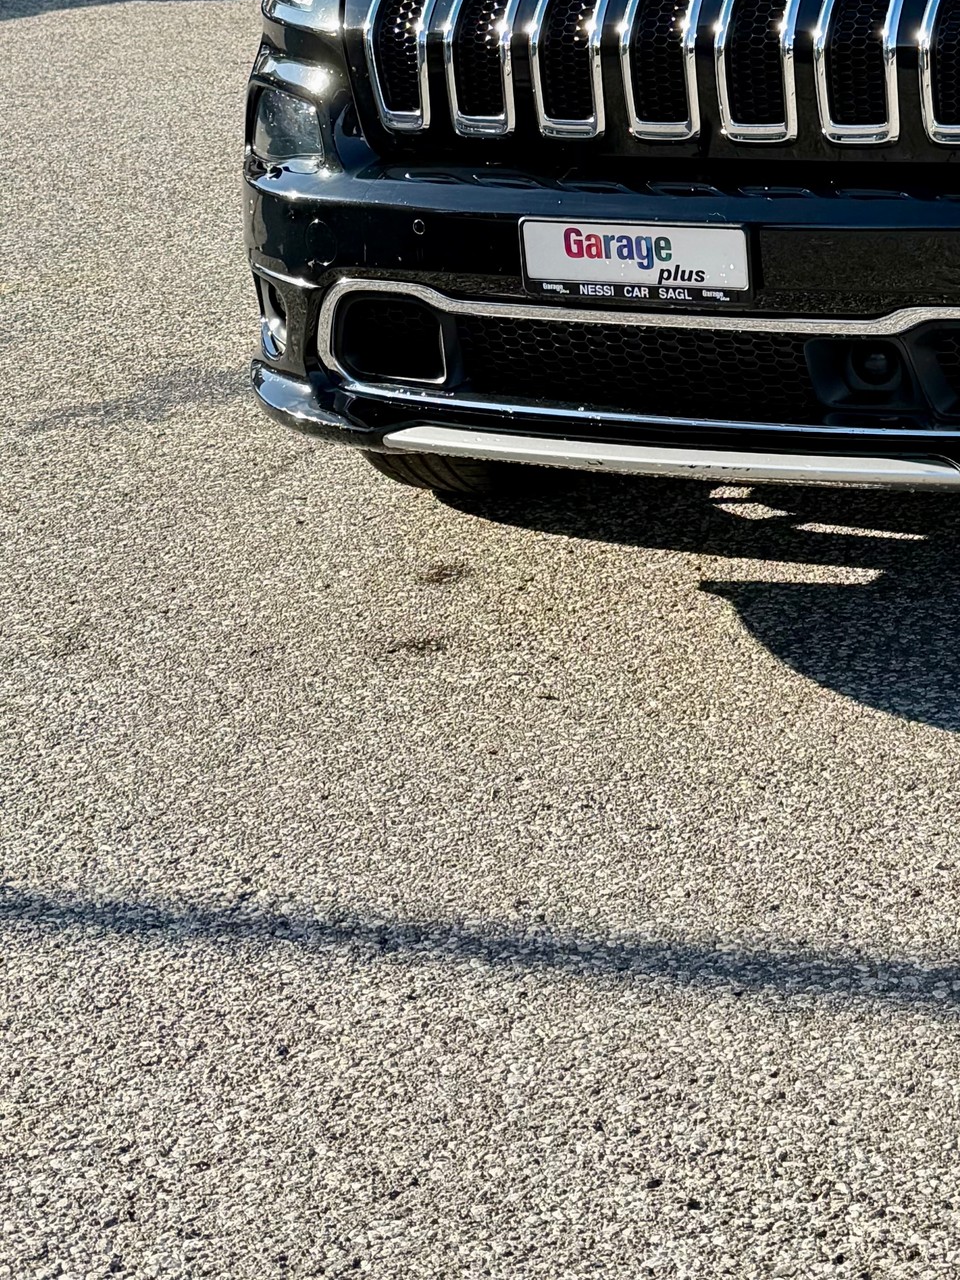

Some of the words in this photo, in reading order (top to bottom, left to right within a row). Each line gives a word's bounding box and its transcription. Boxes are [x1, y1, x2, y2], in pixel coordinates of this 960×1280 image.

[563, 227, 673, 270] Garage
[657, 264, 706, 285] plus
[579, 284, 615, 297] NESSI
[623, 286, 650, 298] CAR
[658, 287, 693, 301] SAGL
